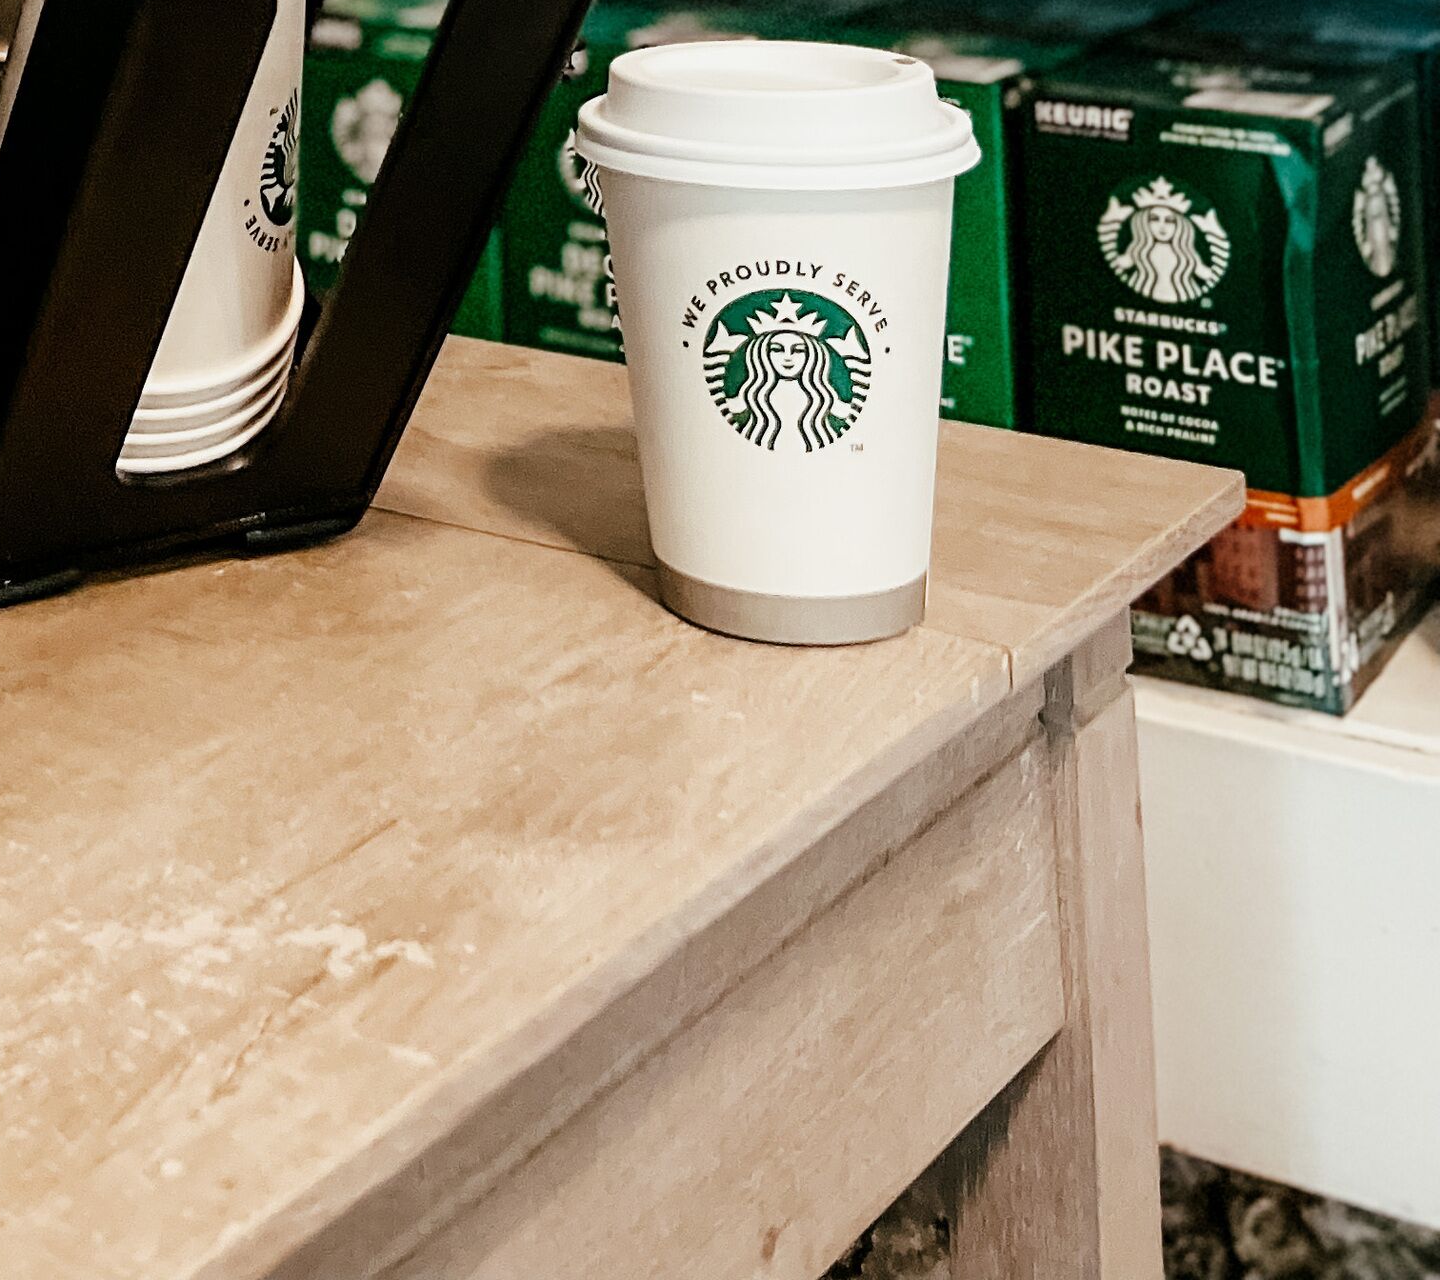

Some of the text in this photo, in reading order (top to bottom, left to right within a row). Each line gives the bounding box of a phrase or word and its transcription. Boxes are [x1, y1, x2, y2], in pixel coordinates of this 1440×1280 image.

[1033, 100, 1133, 133] KEURIG
[681, 260, 889, 335] WE PROUDLY SERVE
[1113, 306, 1223, 337] STARBUCKS
[1061, 323, 1280, 389] PIKE PLACE
[1124, 371, 1212, 407] ROAST
[1177, 414, 1220, 433] COCOA
